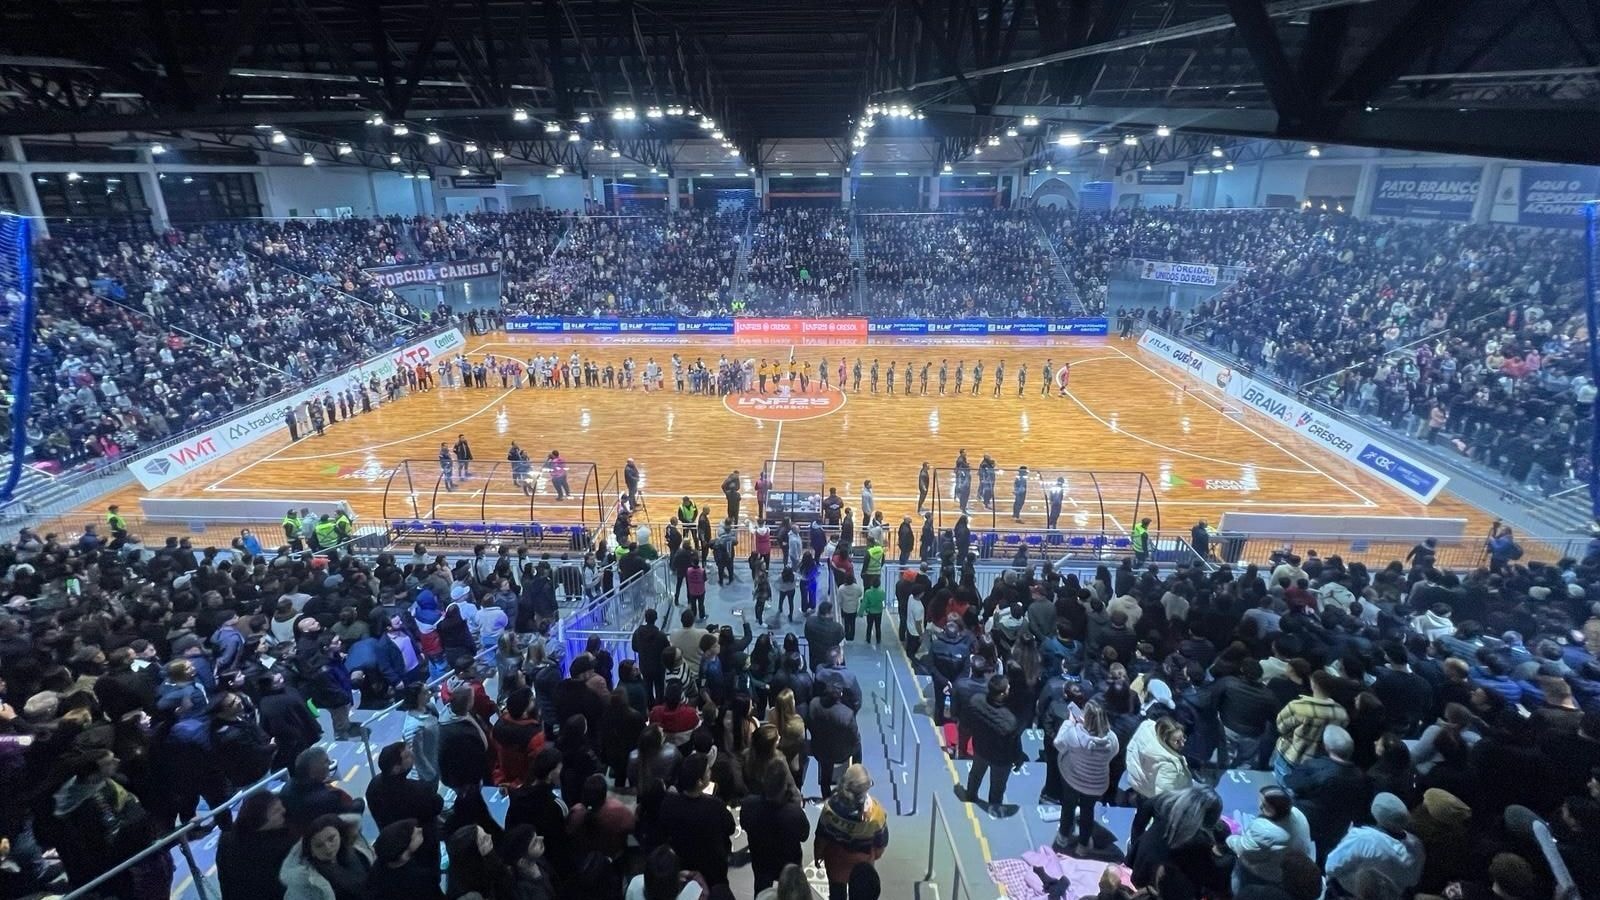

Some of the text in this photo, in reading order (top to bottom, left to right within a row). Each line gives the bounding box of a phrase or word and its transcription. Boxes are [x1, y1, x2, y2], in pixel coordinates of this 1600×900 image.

[1380, 180, 1415, 191] PATO
[376, 269, 437, 286] TORCIDA
[440, 263, 488, 278] CAMISA
[1156, 272, 1179, 281] UNIDOS
[1180, 273, 1190, 282] DO
[1172, 264, 1209, 274] TORCIDA
[1242, 388, 1288, 419] BRAVA
[1308, 424, 1353, 453] CRESCER
[169, 437, 217, 466] VMT
